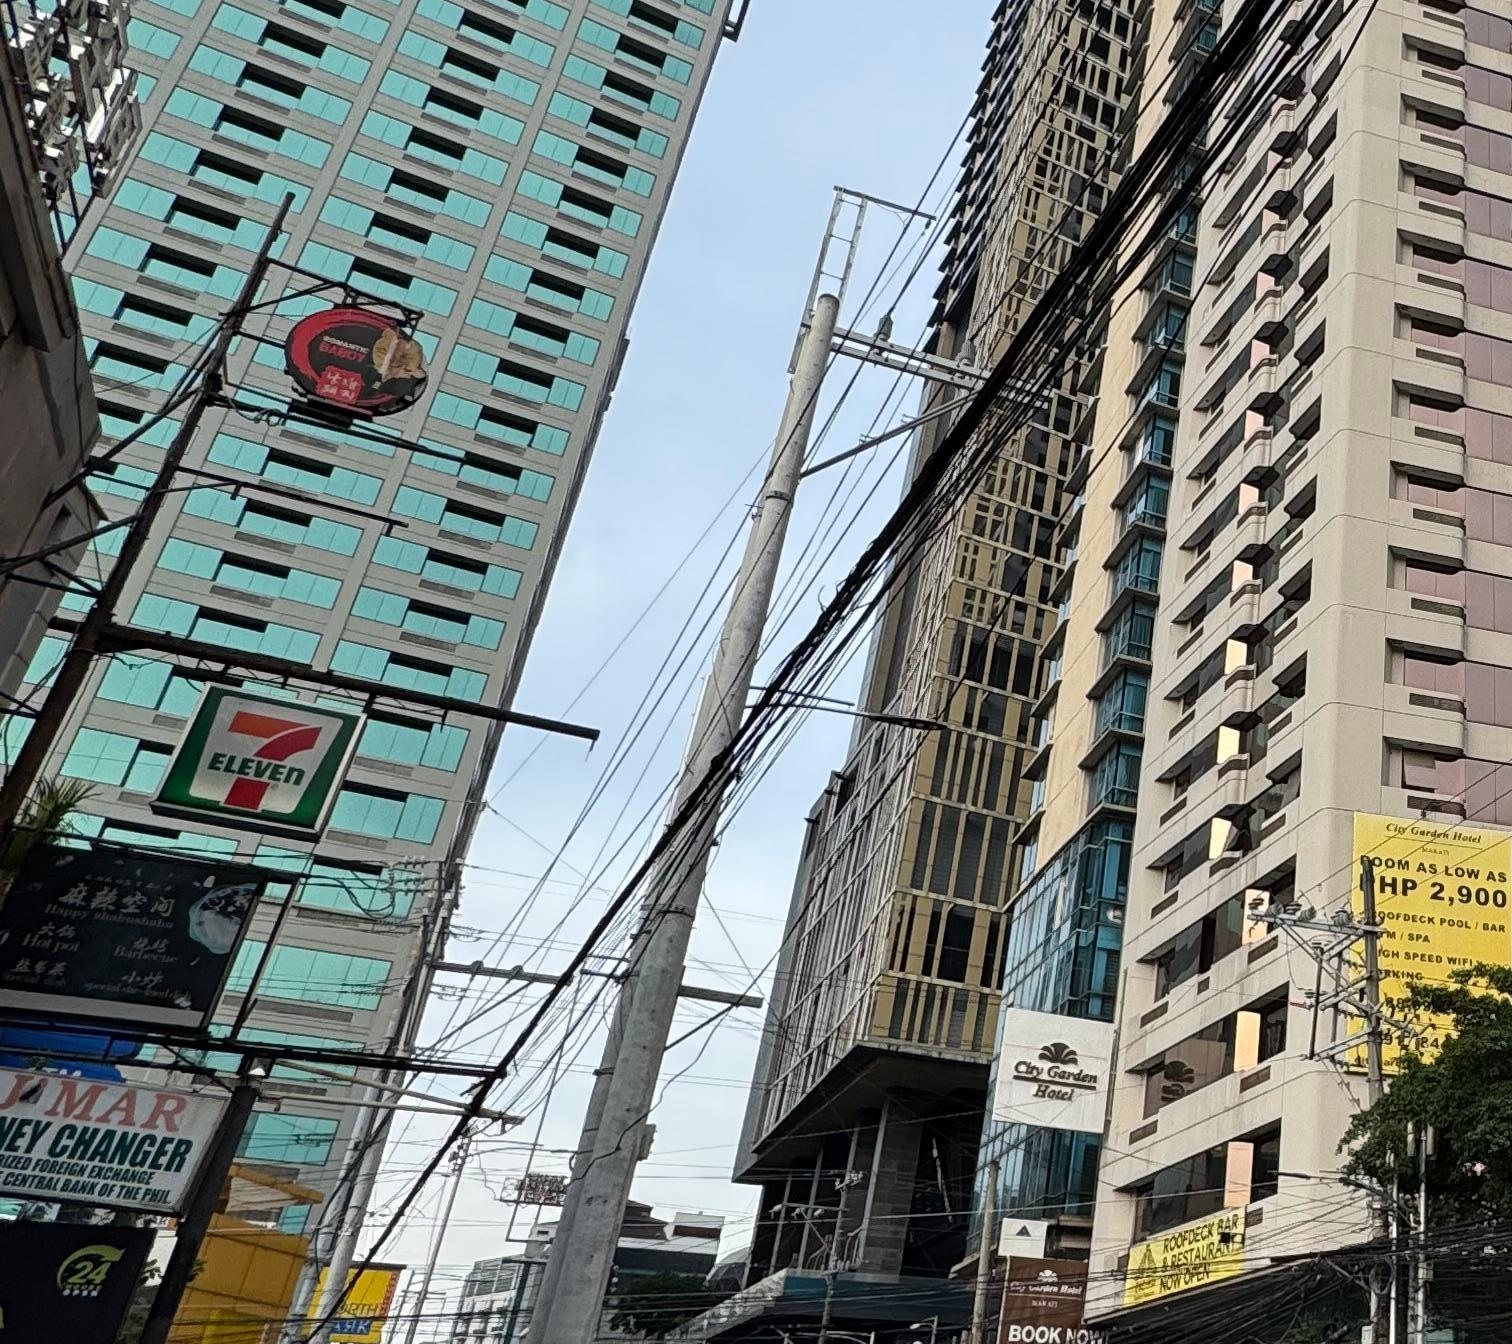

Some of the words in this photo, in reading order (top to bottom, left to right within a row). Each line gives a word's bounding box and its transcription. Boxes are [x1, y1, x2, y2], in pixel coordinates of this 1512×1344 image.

[1386, 822, 1408, 836] City
[1411, 826, 1449, 840] Garden
[1452, 831, 1482, 844] Hotel
[1416, 862, 1438, 875] AS
[1444, 865, 1480, 880] LOW
[1486, 870, 1507, 883] AS
[1360, 873, 1418, 897] HP
[1429, 881, 1507, 909] 2,900
[45, 903, 88, 922] Happy
[1439, 917, 1471, 930] POOL
[1482, 922, 1506, 933] BAR
[1408, 933, 1431, 944] SPA
[1404, 952, 1443, 964] SPEED
[1014, 1060, 1044, 1077] City
[1047, 1066, 1098, 1084] Garden
[1033, 1084, 1074, 1102] Hotel
[48, 1123, 194, 1173] CHANGER
[32, 1158, 87, 1178] FOREIGN
[89, 1165, 157, 1186] EXCHANGE
[3, 1171, 59, 1193] CENTRAL
[60, 1178, 96, 1197] BANK
[97, 1183, 117, 1198] OF
[119, 1185, 140, 1202] THE
[1163, 1221, 1215, 1255] ROOFDECK
[1217, 1213, 1239, 1236] BAR
[70, 1260, 112, 1285] 24
[1160, 1275, 1181, 1294] NOW
[1008, 1325, 1062, 1344] BOOK
